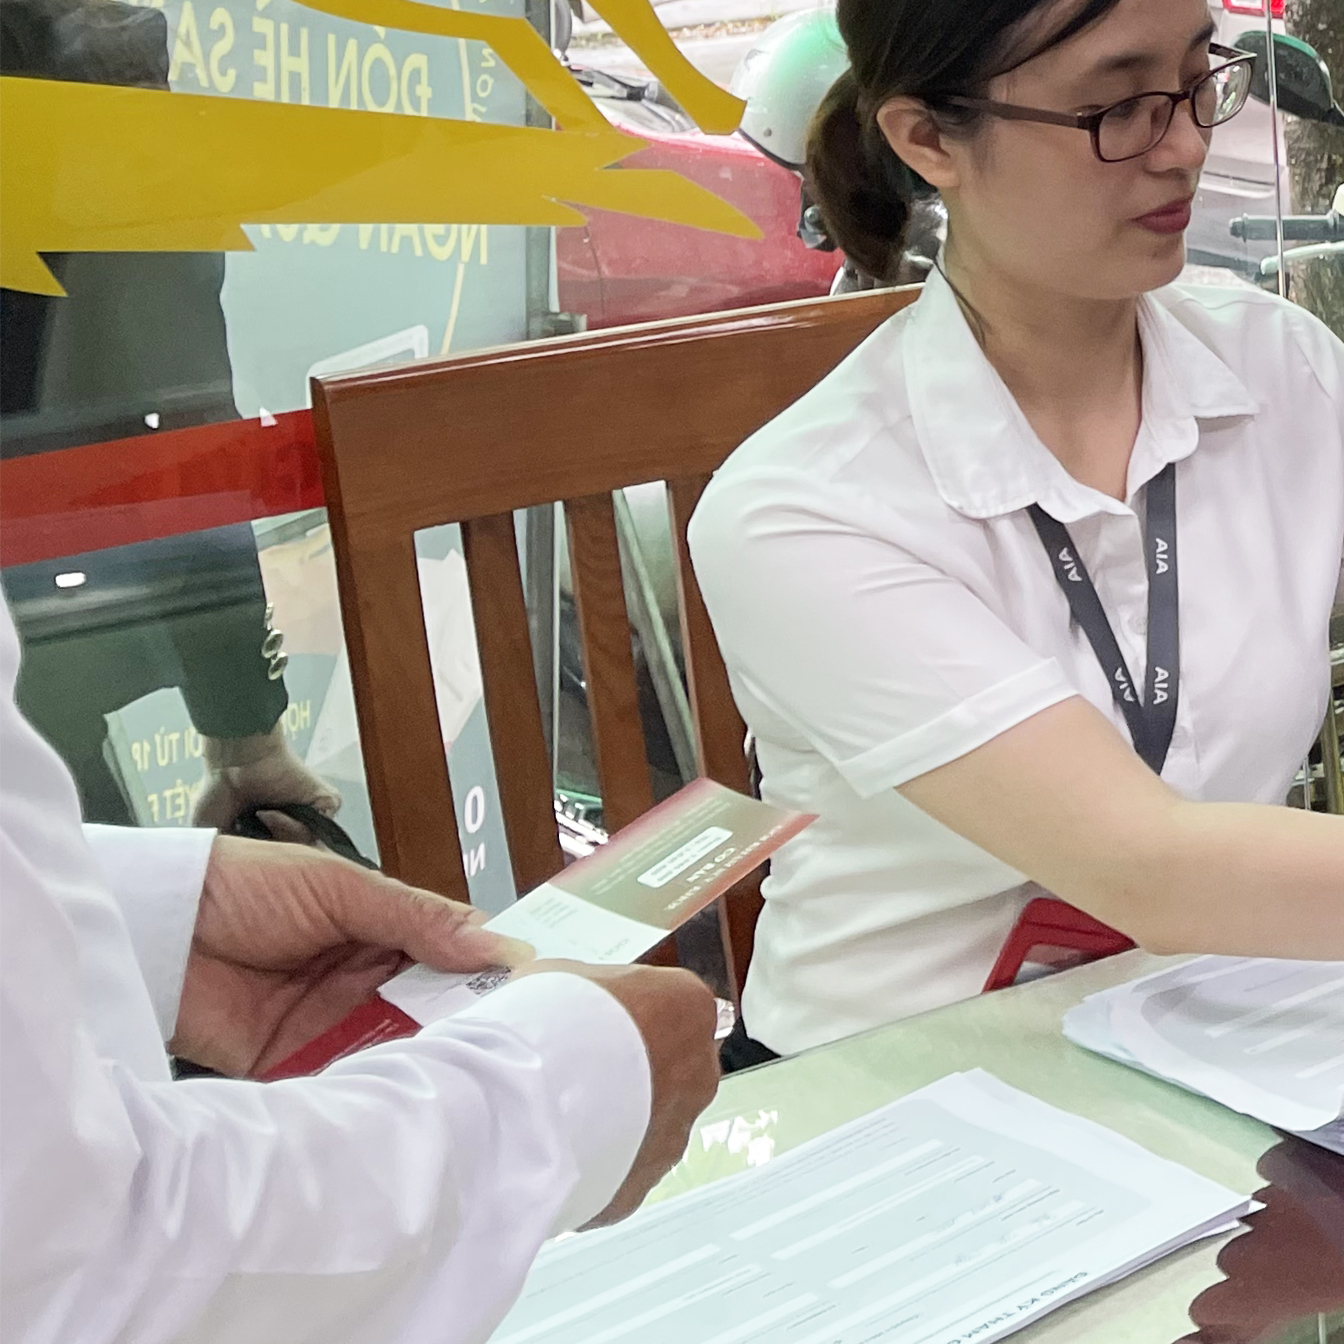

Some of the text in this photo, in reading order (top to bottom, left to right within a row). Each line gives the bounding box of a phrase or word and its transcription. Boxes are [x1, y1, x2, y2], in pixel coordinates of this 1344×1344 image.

[1058, 546, 1083, 583] AIA
[1154, 537, 1169, 575] AIA
[1153, 665, 1170, 706] AIA
